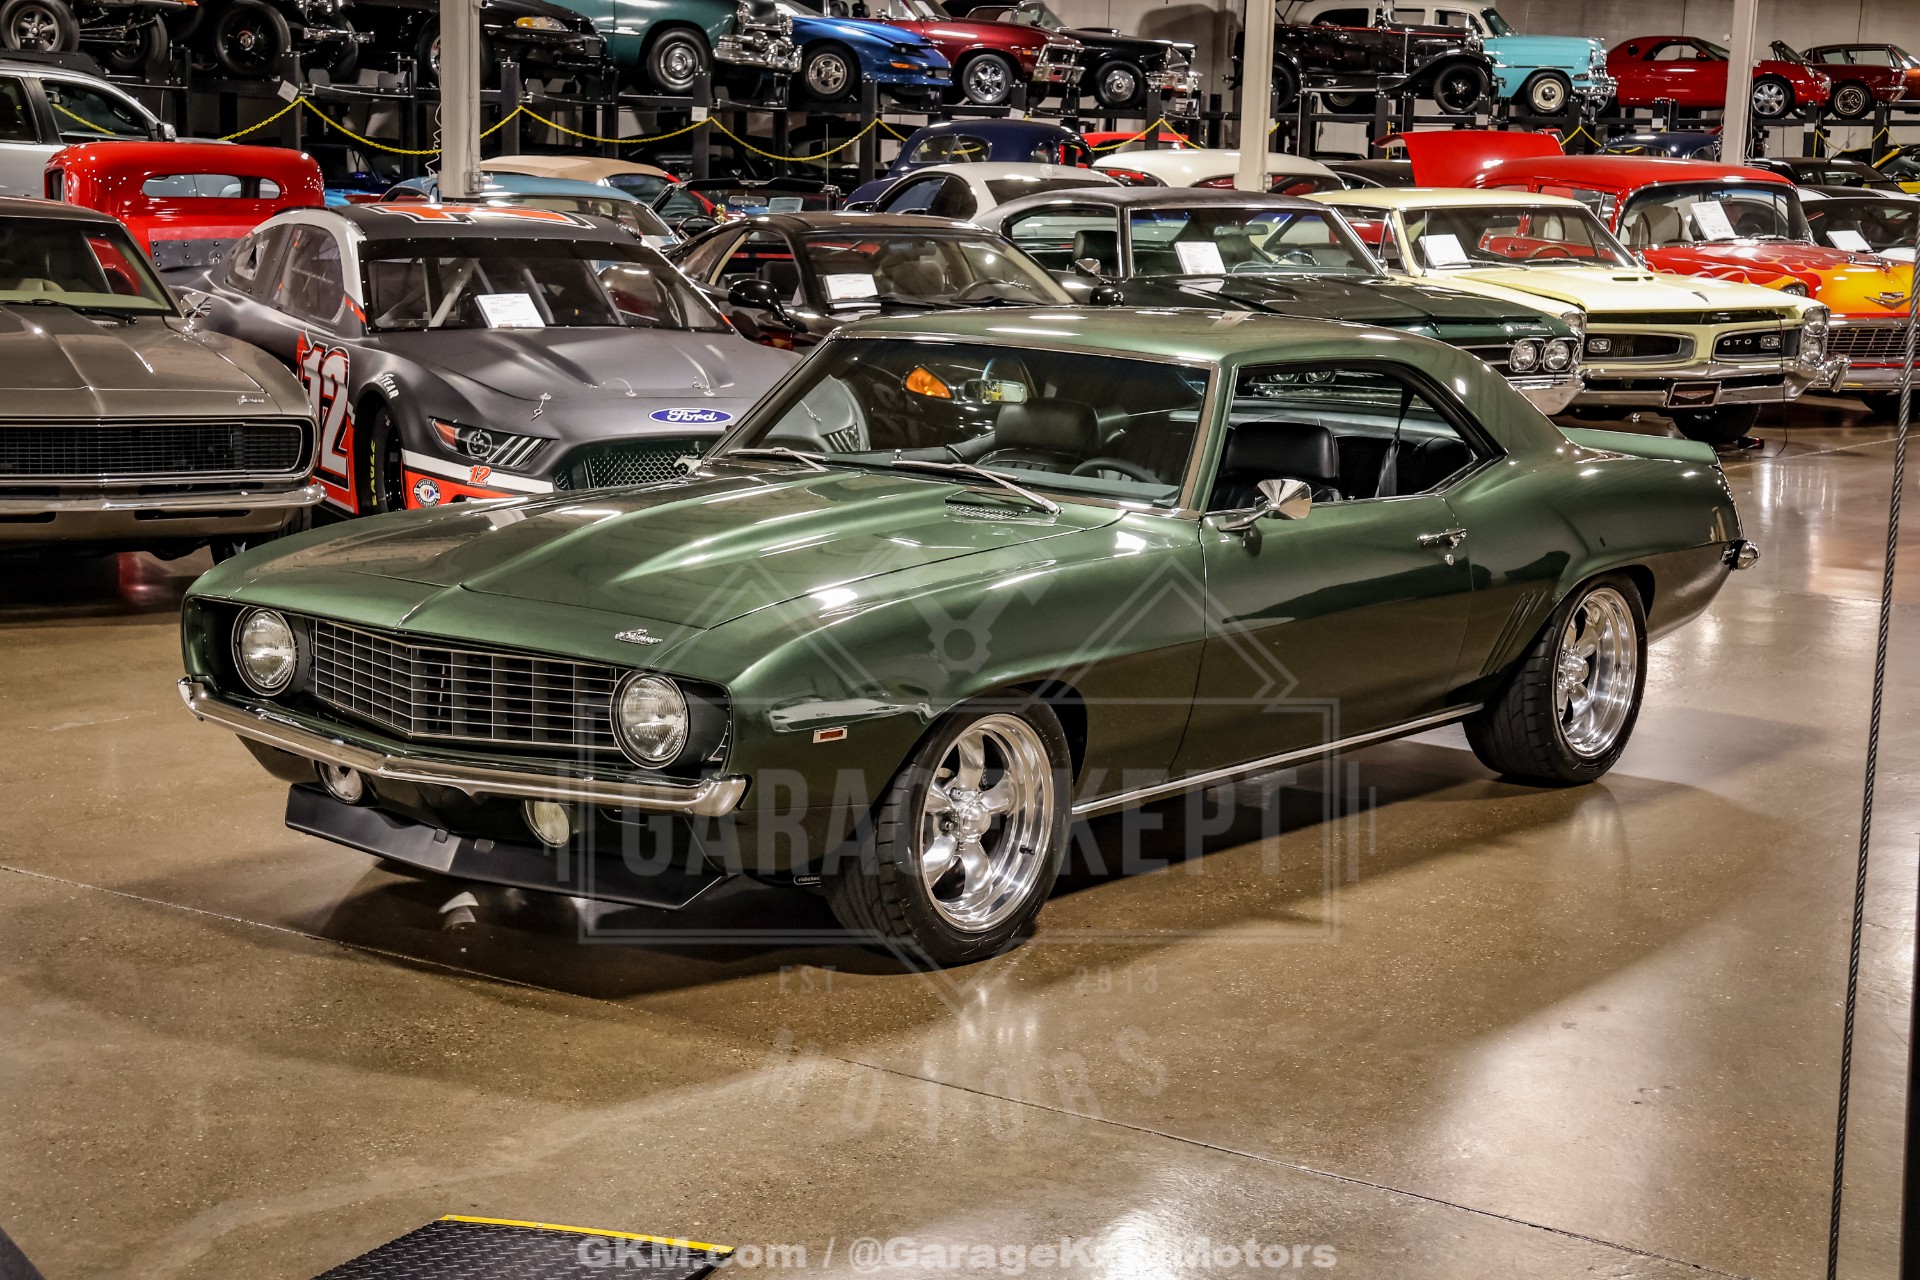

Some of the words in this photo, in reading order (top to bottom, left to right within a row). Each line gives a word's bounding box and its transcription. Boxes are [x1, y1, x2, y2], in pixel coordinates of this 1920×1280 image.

[1723, 338, 1752, 346] GTO
[302, 346, 349, 479] 12
[667, 409, 717, 421] Ford
[467, 465, 491, 486] 12
